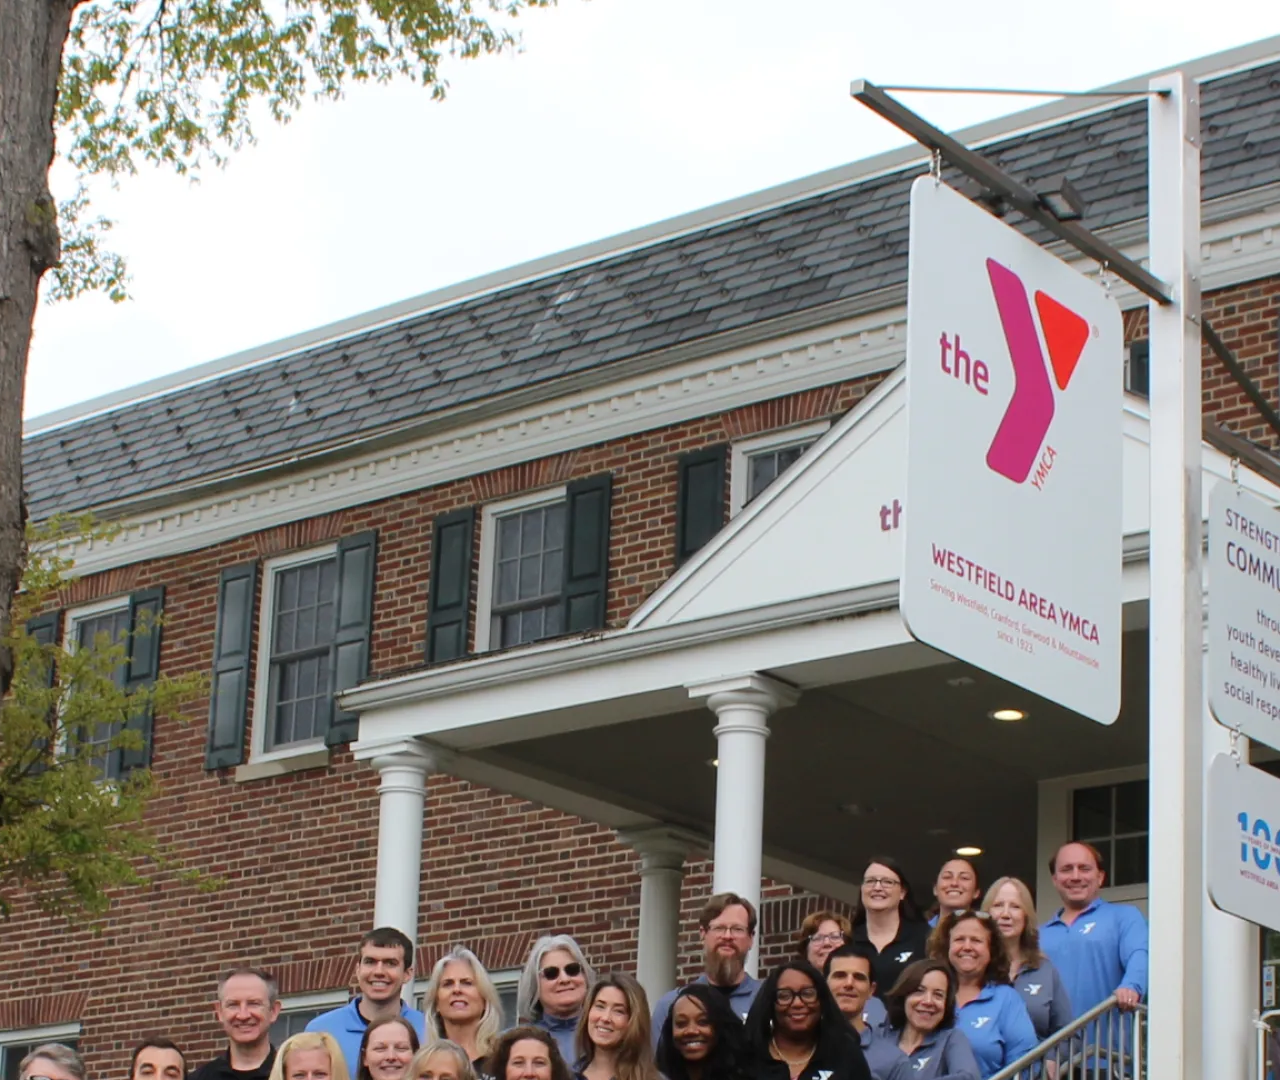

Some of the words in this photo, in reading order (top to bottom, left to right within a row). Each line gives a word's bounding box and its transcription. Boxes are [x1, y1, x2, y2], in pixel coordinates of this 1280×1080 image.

[940, 331, 989, 396] the
[1031, 445, 1057, 492] YMCA
[880, 499, 902, 531] th
[931, 542, 1015, 602] WESTFIELD
[1019, 588, 1057, 624] AREA
[1059, 607, 1100, 645] YMCA
[1226, 623, 1256, 649] youth
[1230, 651, 1268, 688] healthy
[1224, 681, 1254, 706] social
